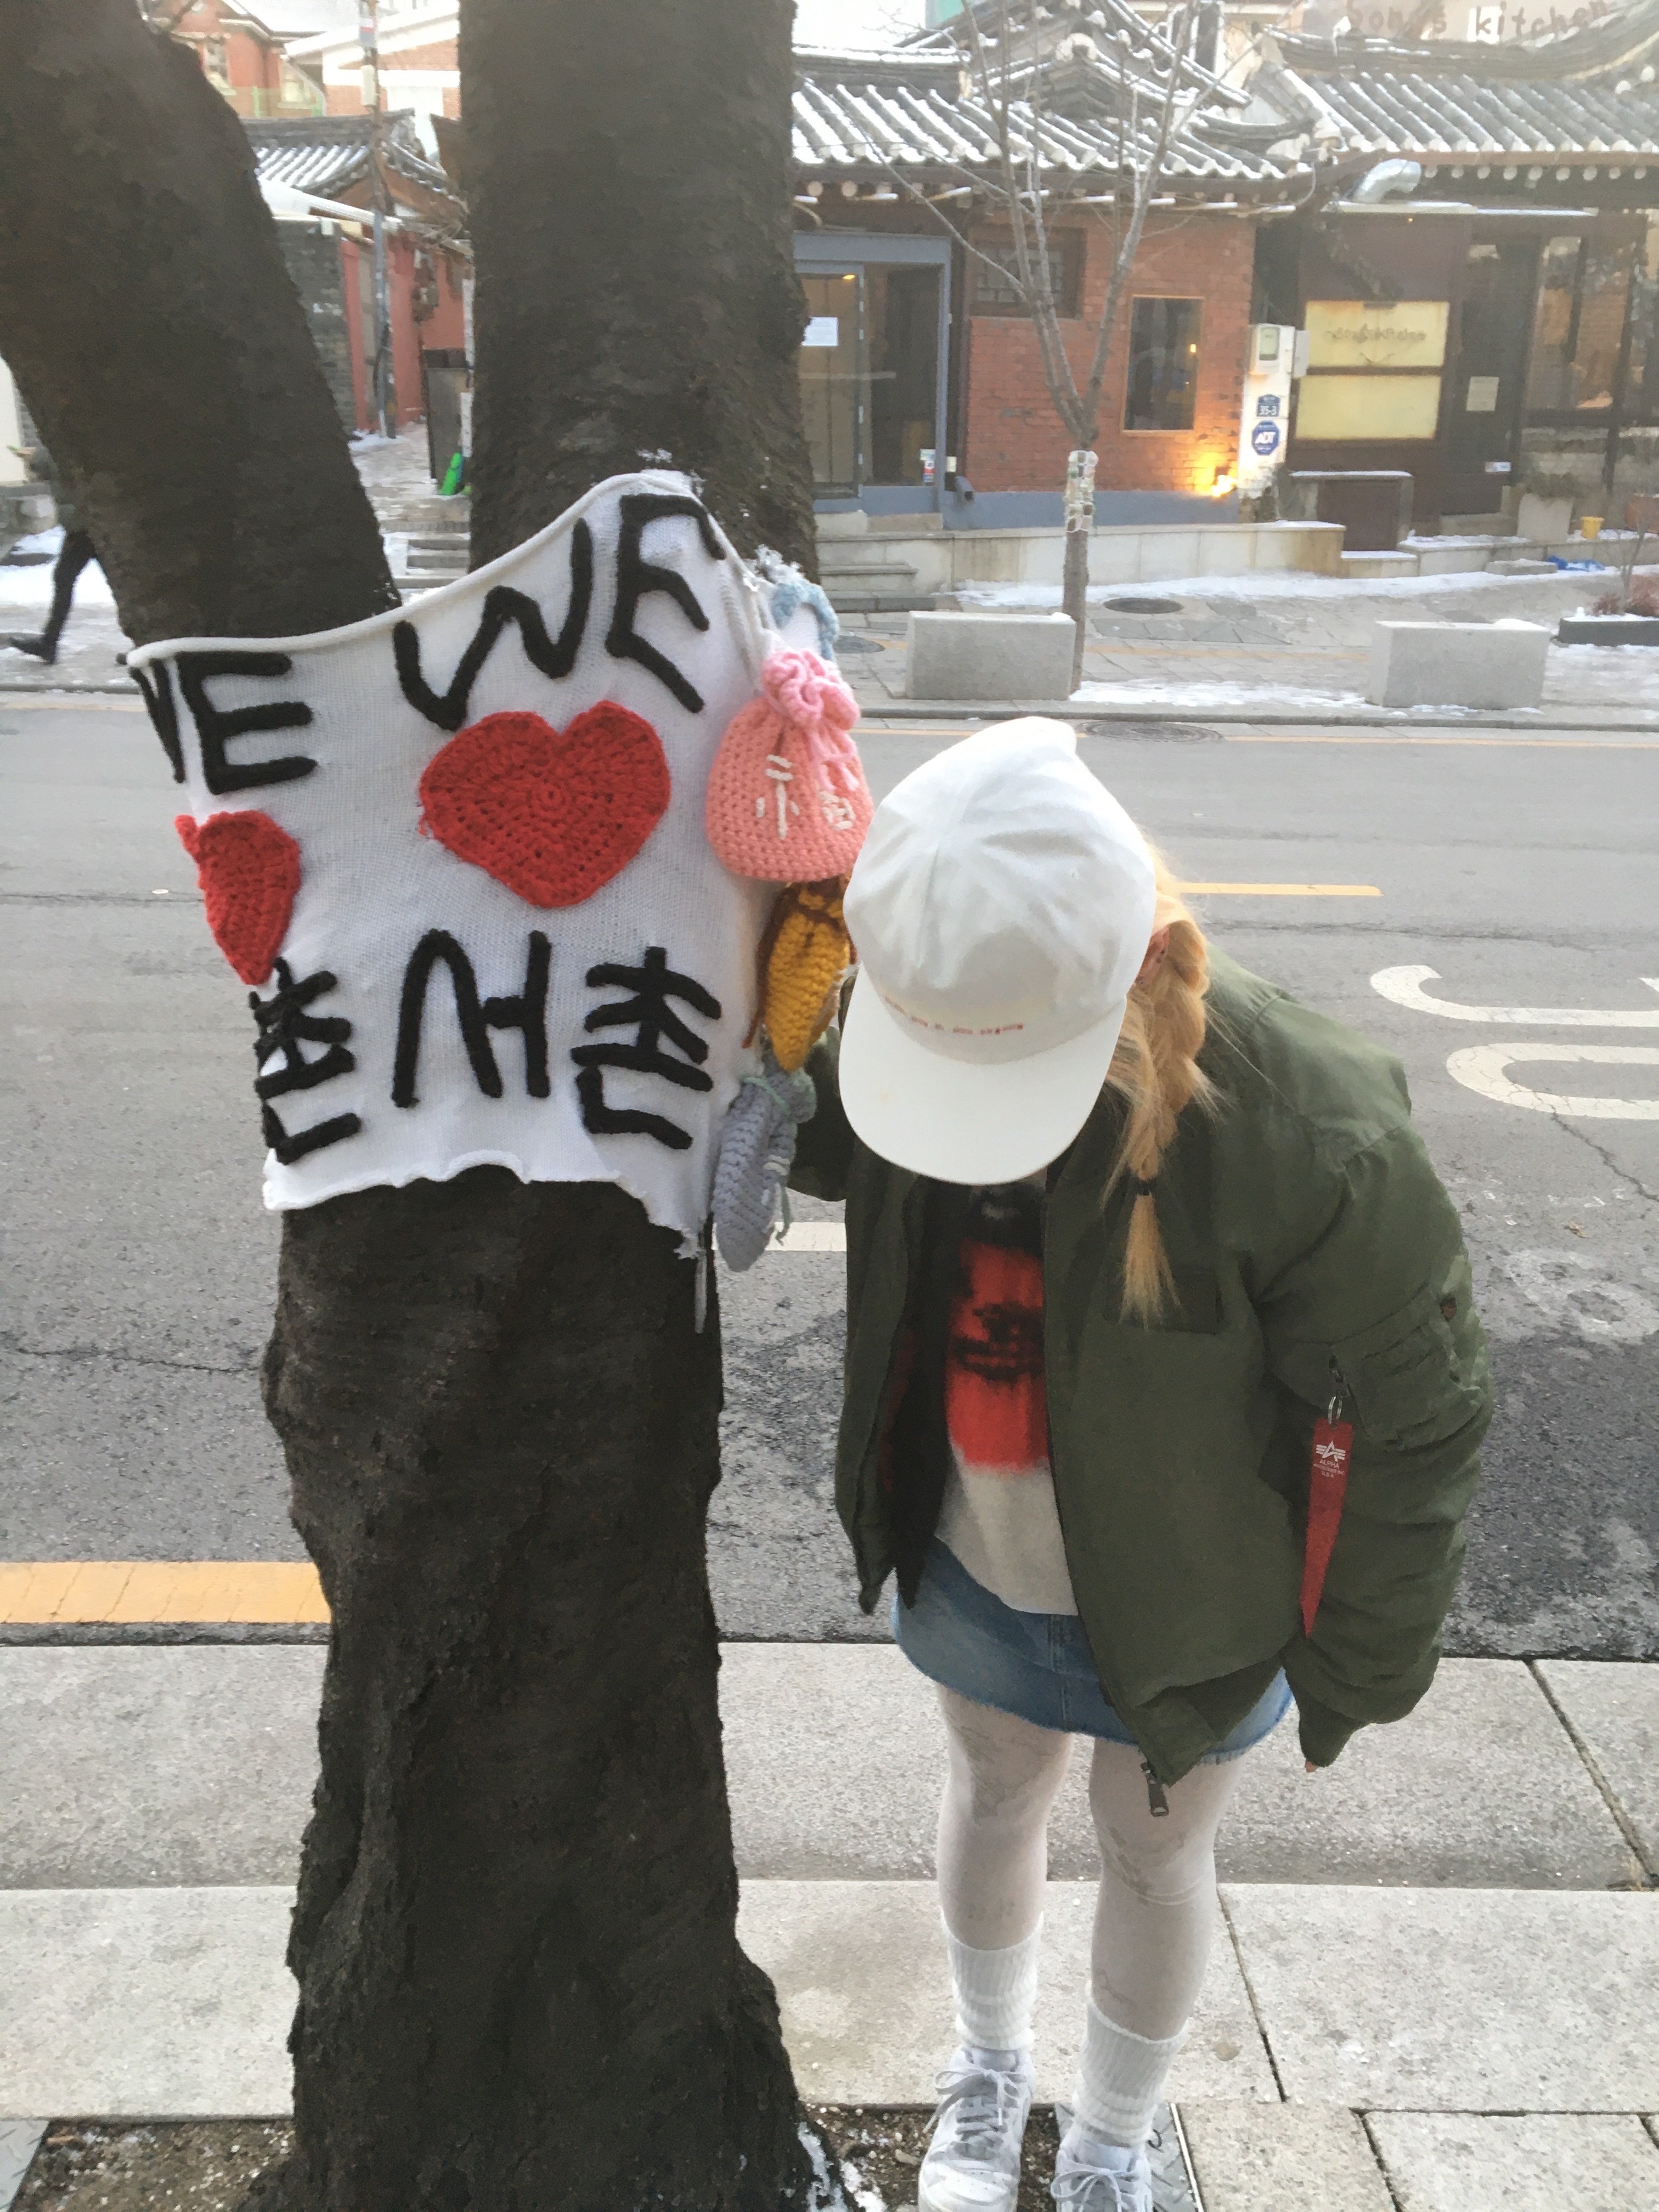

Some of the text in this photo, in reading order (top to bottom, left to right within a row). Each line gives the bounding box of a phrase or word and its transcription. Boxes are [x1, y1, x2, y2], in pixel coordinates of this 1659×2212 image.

[1254, 431, 1277, 444] ADT
[394, 494, 726, 731] WE
[392, 929, 722, 1150] 서촌
[1319, 1458, 1340, 1469] ALPHA
